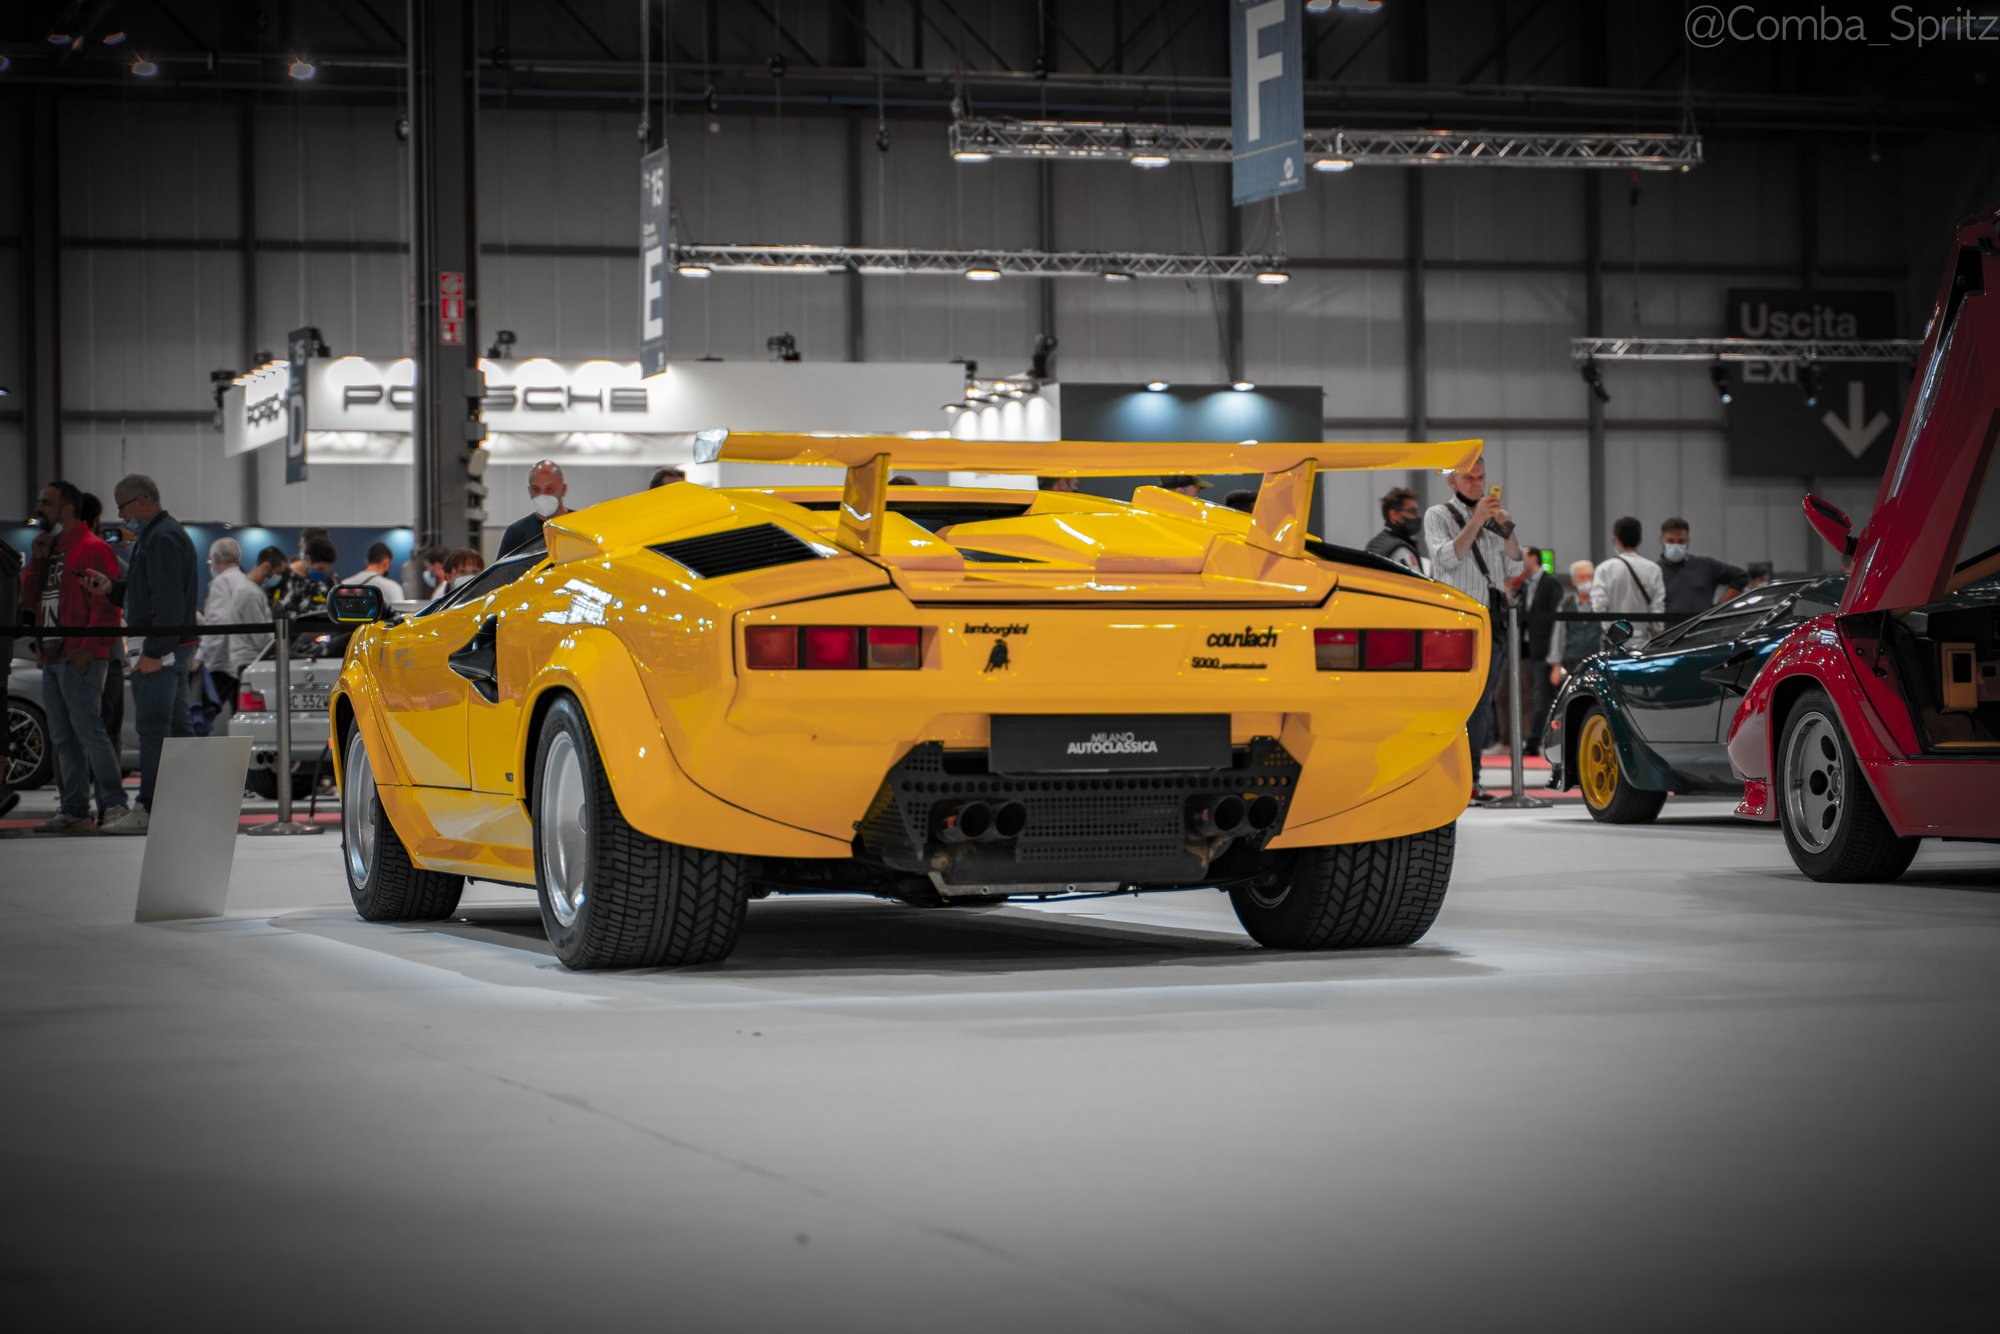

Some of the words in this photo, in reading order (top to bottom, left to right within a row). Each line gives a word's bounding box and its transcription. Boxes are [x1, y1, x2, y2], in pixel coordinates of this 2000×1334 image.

[1246, 0, 1286, 142] F
[644, 246, 663, 341] E
[1740, 302, 1858, 338] Uscita
[344, 384, 648, 412] POSCHE
[289, 393, 305, 457] D
[964, 622, 1030, 637] lamborghini
[1206, 625, 1278, 648] countach
[1191, 656, 1220, 669] 5000
[1066, 740, 1158, 754] AUTOCLASSICA
[1090, 732, 1135, 742] MILANO
